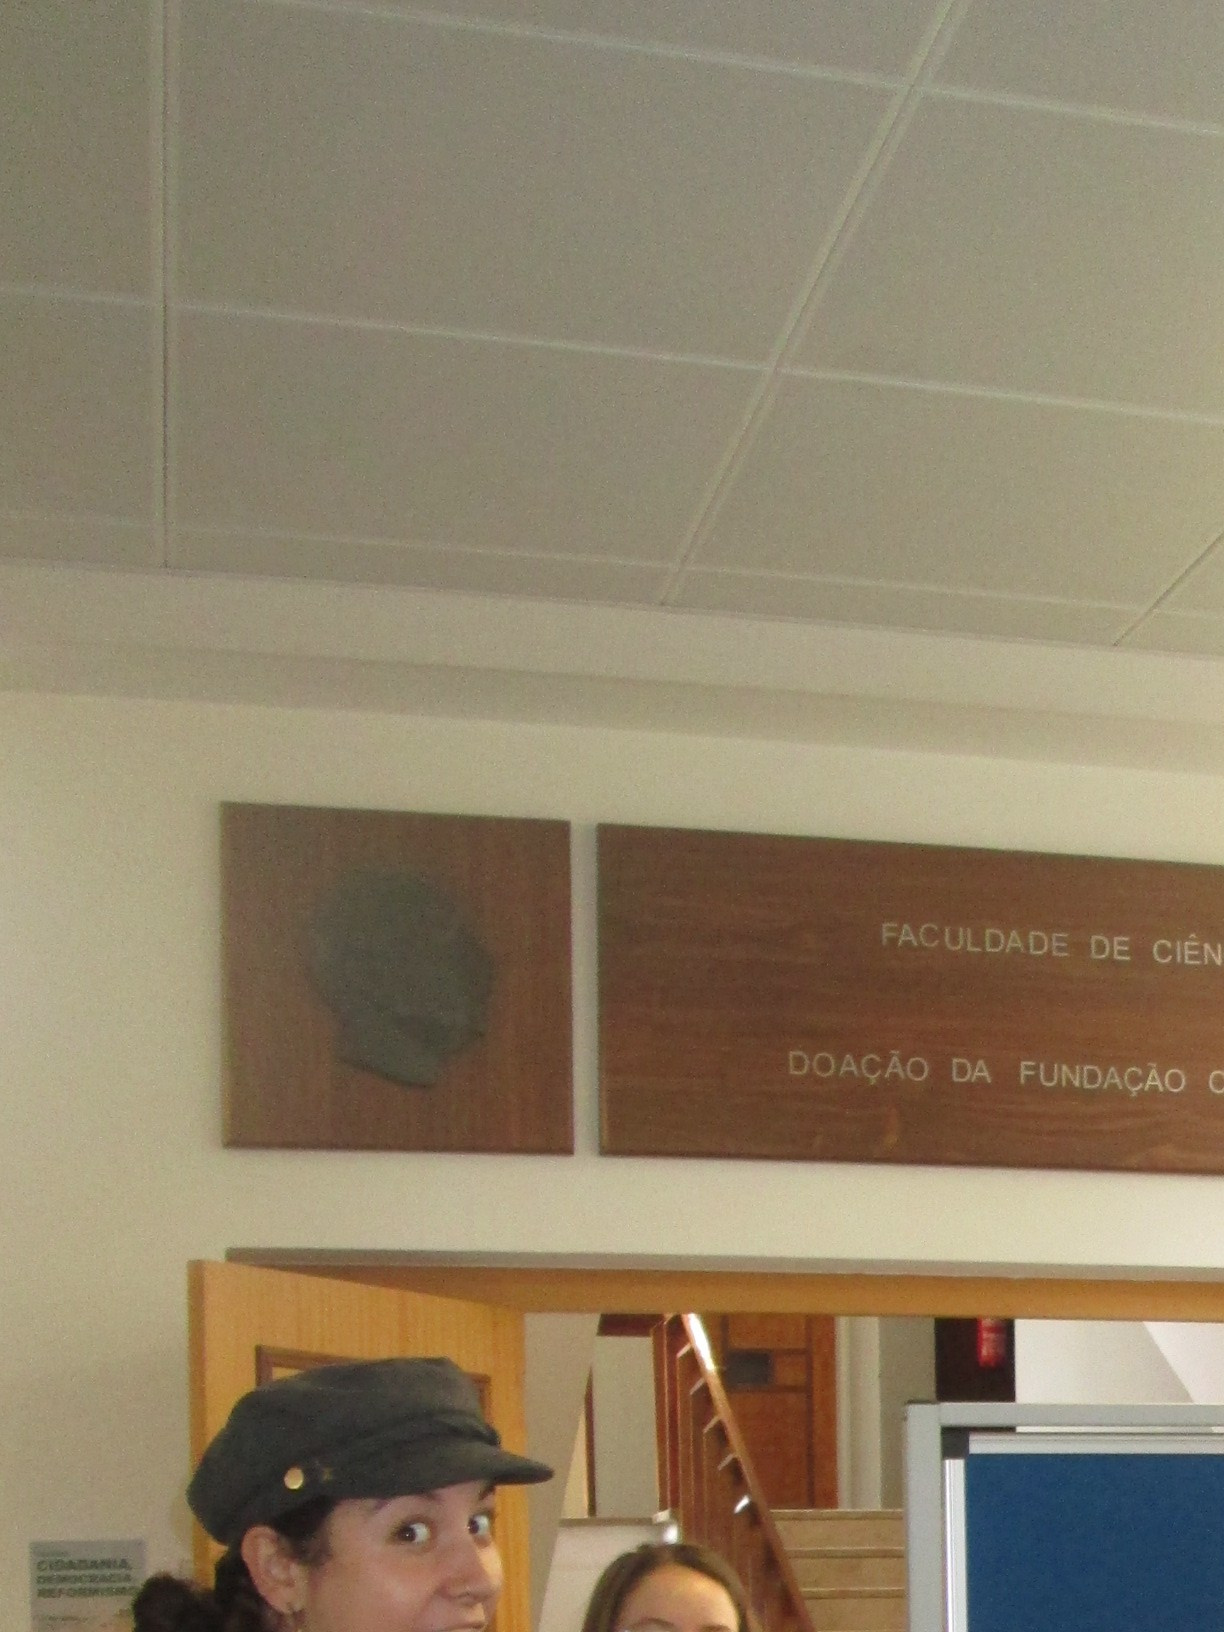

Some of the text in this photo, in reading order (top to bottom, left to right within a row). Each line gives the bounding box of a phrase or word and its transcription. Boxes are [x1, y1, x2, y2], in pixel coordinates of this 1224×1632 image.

[881, 923, 1070, 958] FACULDADE
[1090, 934, 1131, 961] DE
[788, 1050, 929, 1085] DOAÇÃO
[951, 1057, 992, 1084] DA
[1019, 1061, 1186, 1097] FUNDAÇÃO
